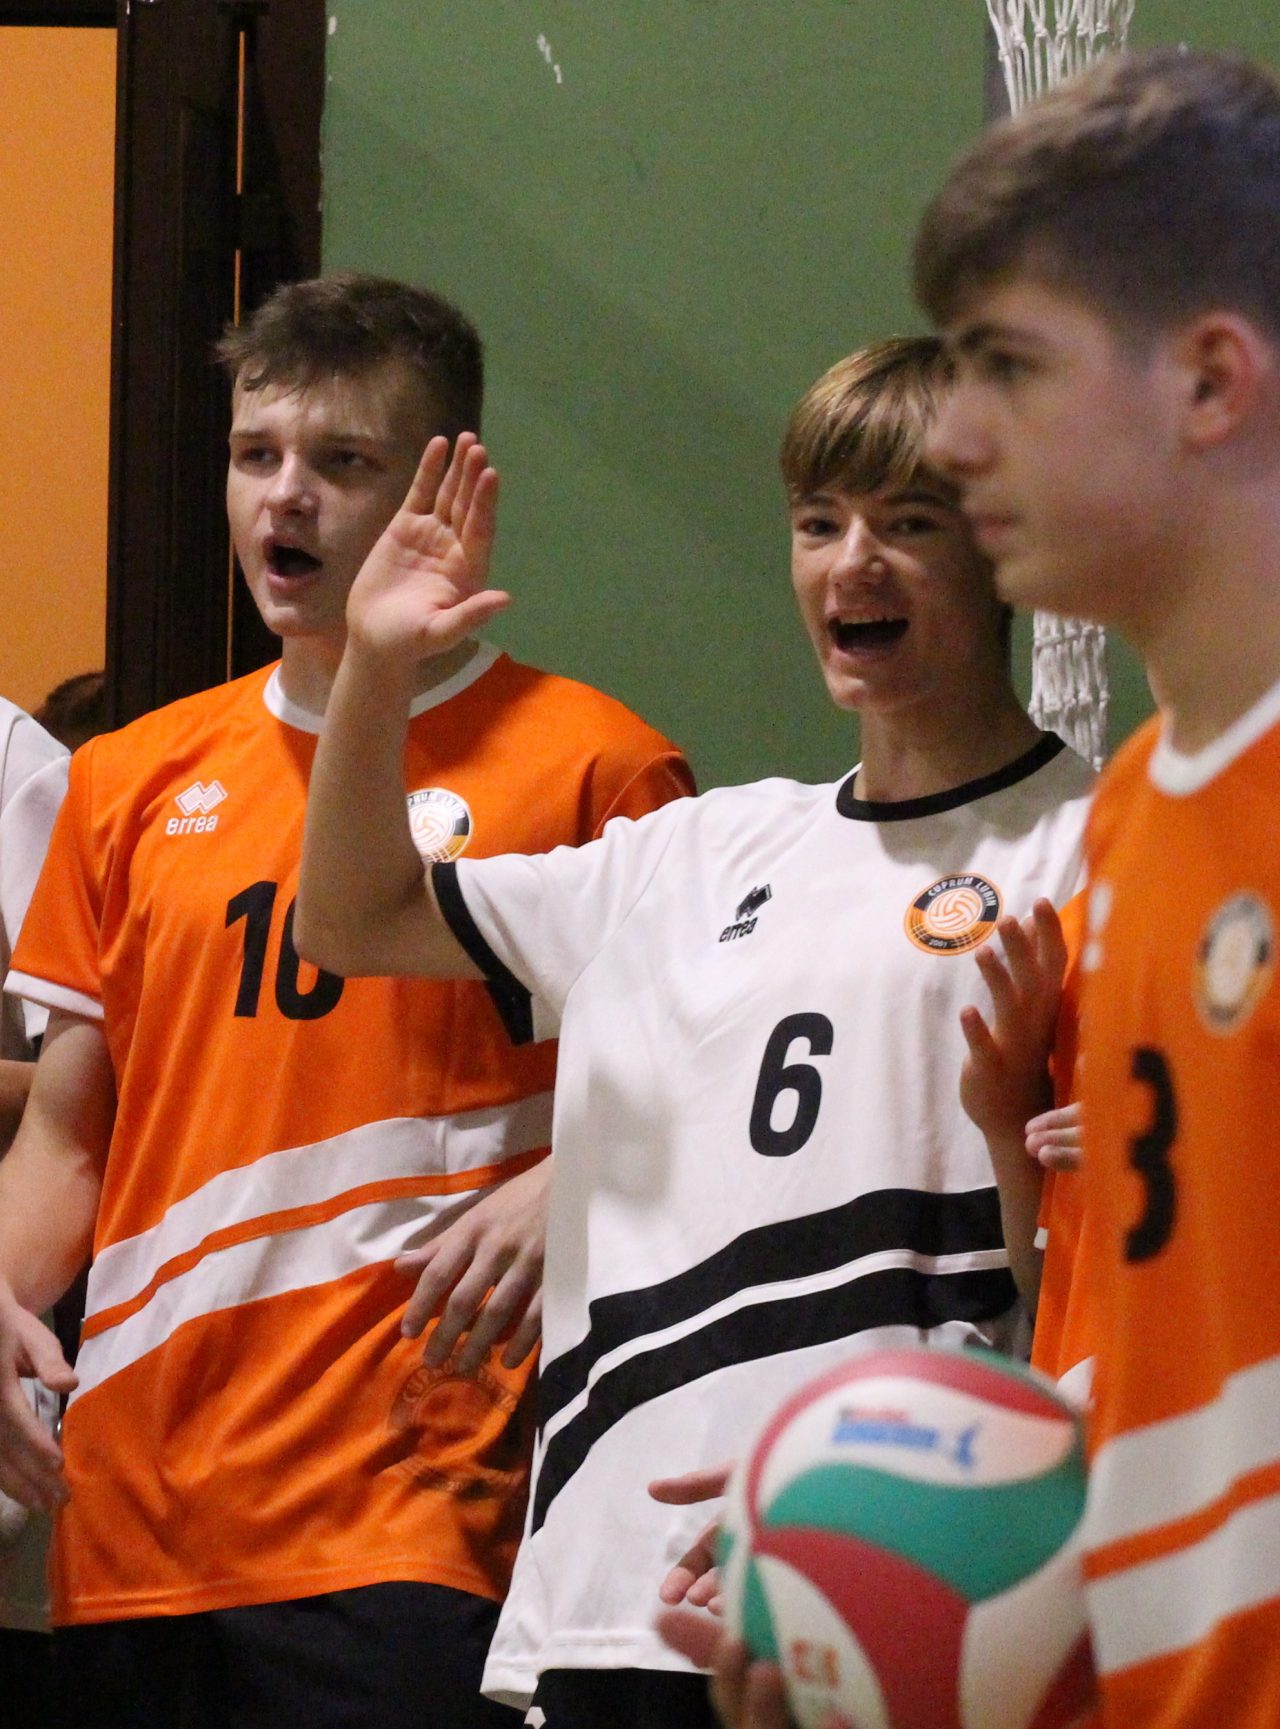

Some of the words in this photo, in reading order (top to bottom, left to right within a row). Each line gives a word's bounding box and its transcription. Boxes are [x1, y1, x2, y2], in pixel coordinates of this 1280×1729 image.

[165, 814, 220, 837] errea
[927, 876, 975, 897] CUPRUM
[975, 881, 998, 907] LUBIN
[718, 916, 758, 943] errea
[749, 1011, 834, 1157] 6
[1124, 1046, 1180, 1265] 3
